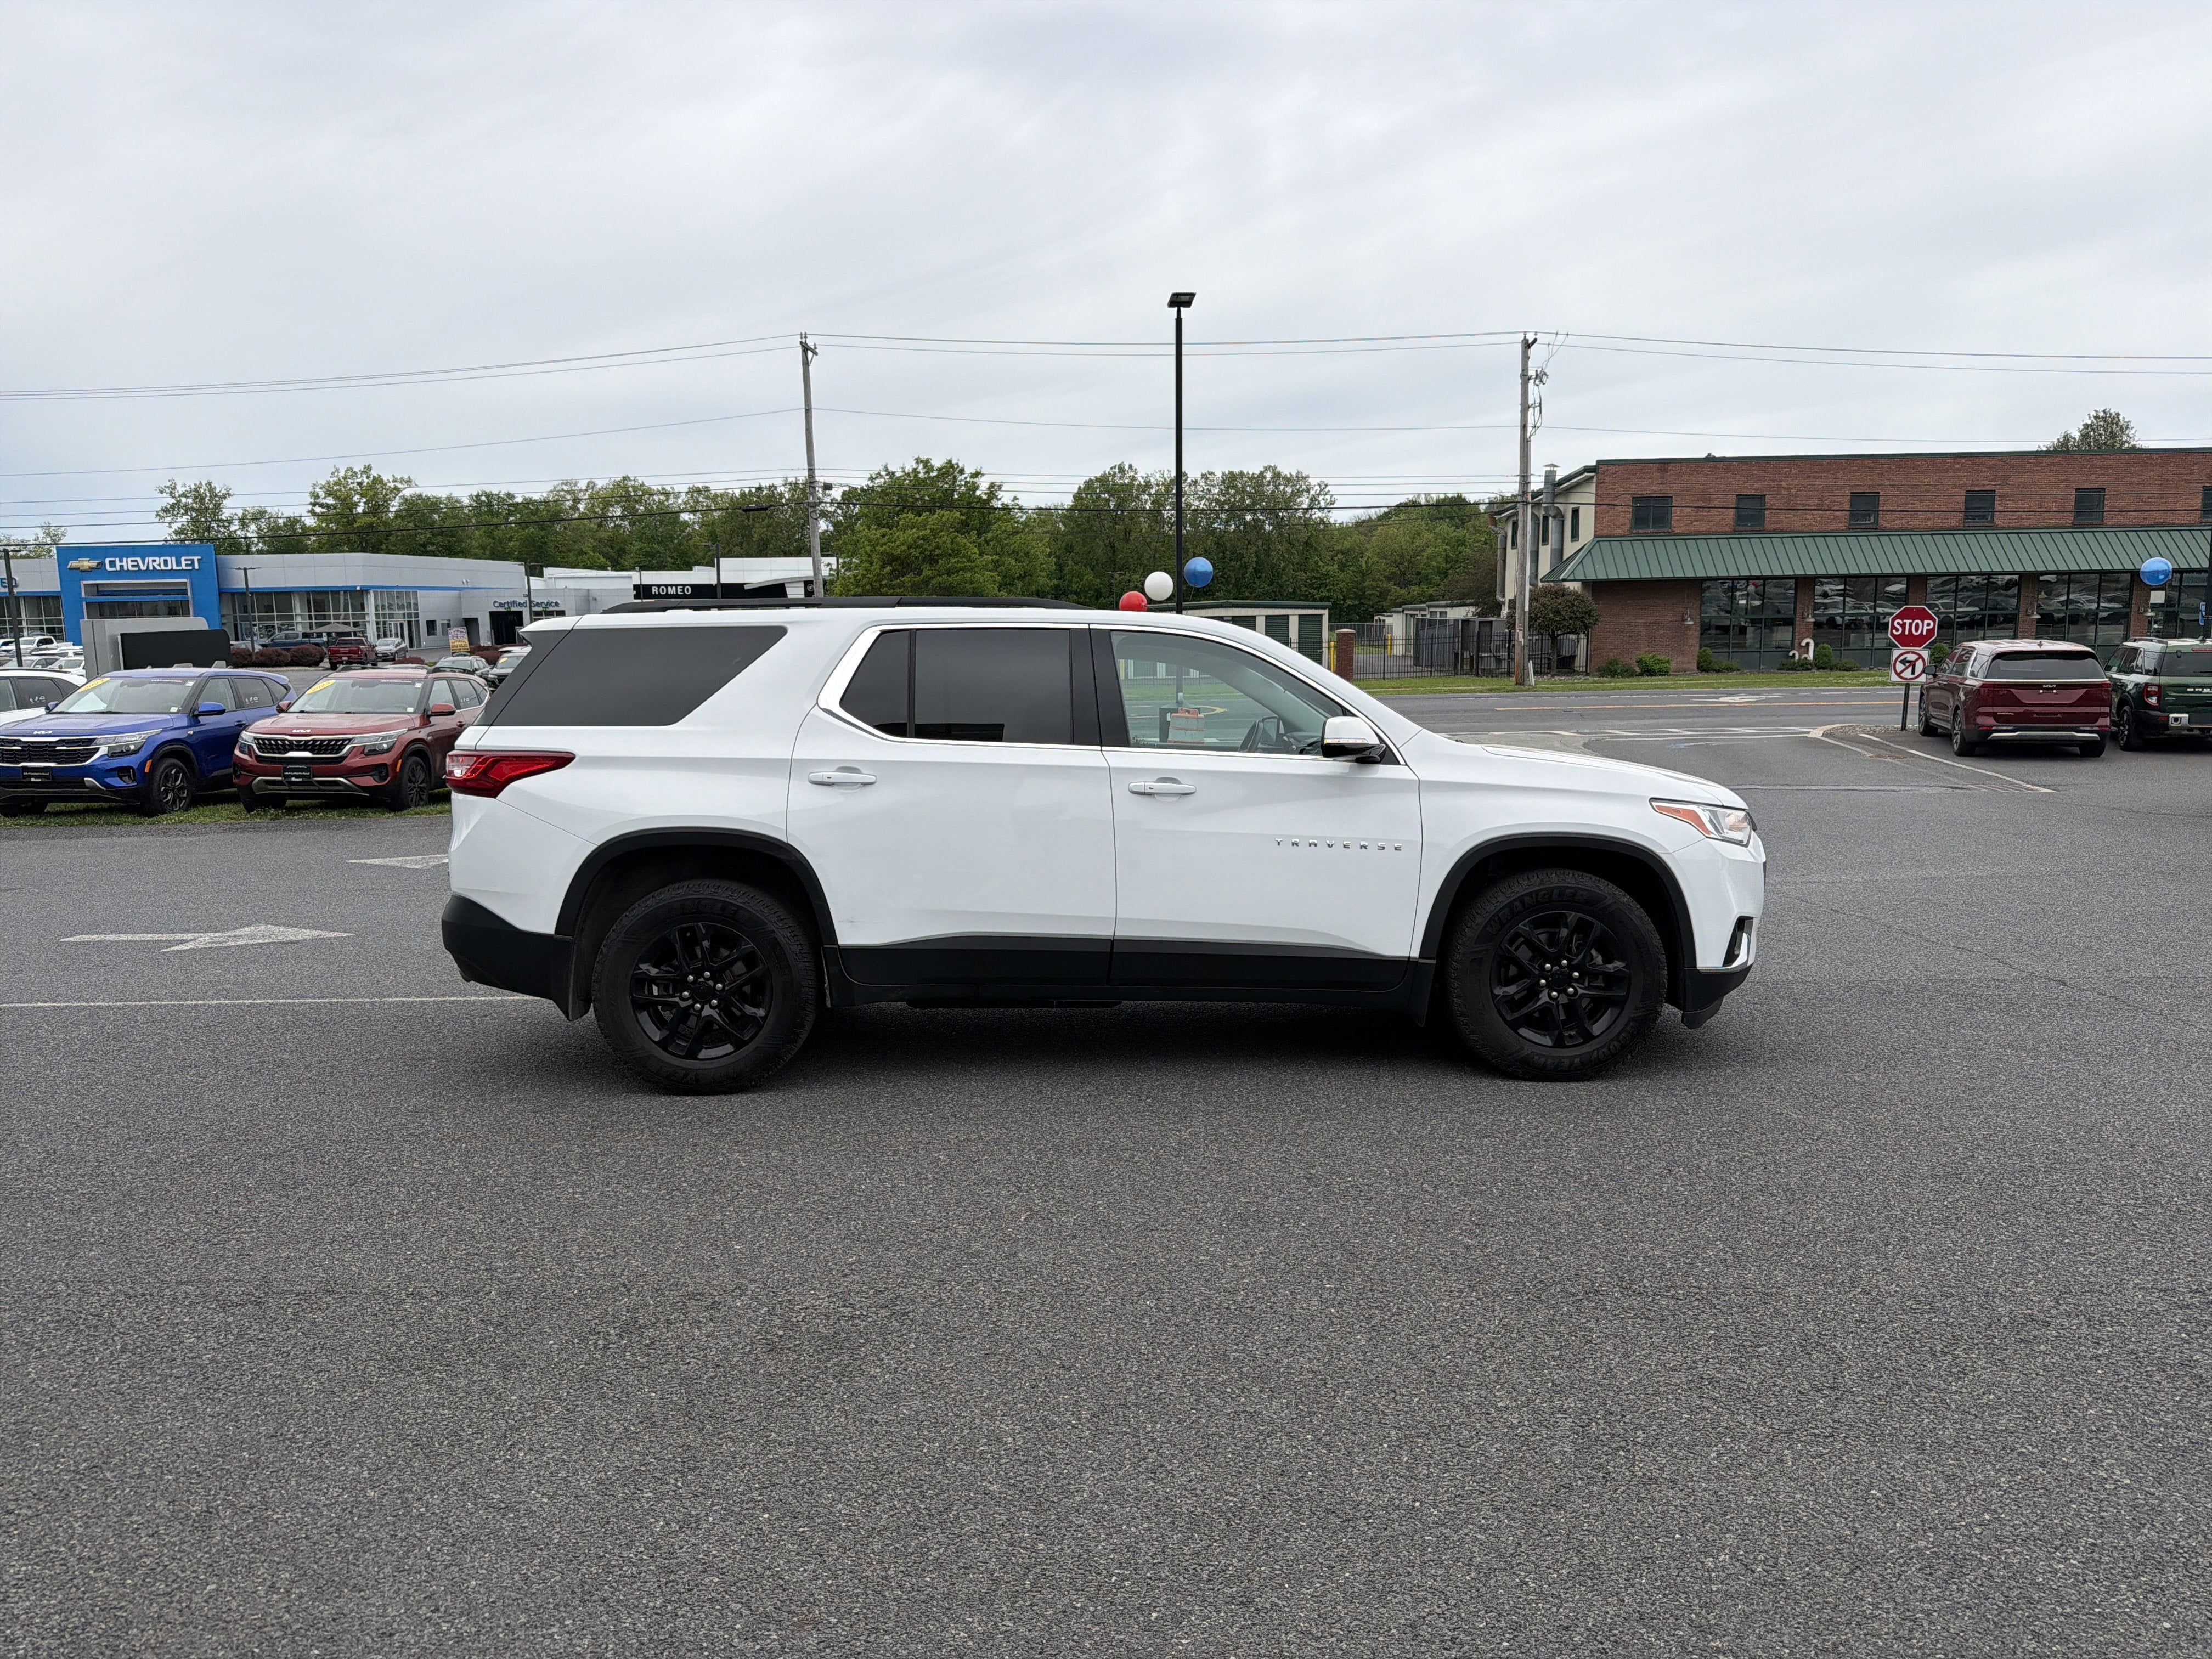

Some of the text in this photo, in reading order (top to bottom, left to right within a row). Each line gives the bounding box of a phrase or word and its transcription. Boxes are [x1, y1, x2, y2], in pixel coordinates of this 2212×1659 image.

[105, 556, 201, 571] CHEVROLET
[652, 585, 692, 595] ROMEO
[1892, 619, 1934, 635] STOP
[1275, 838, 1403, 851] TRAVERSE
